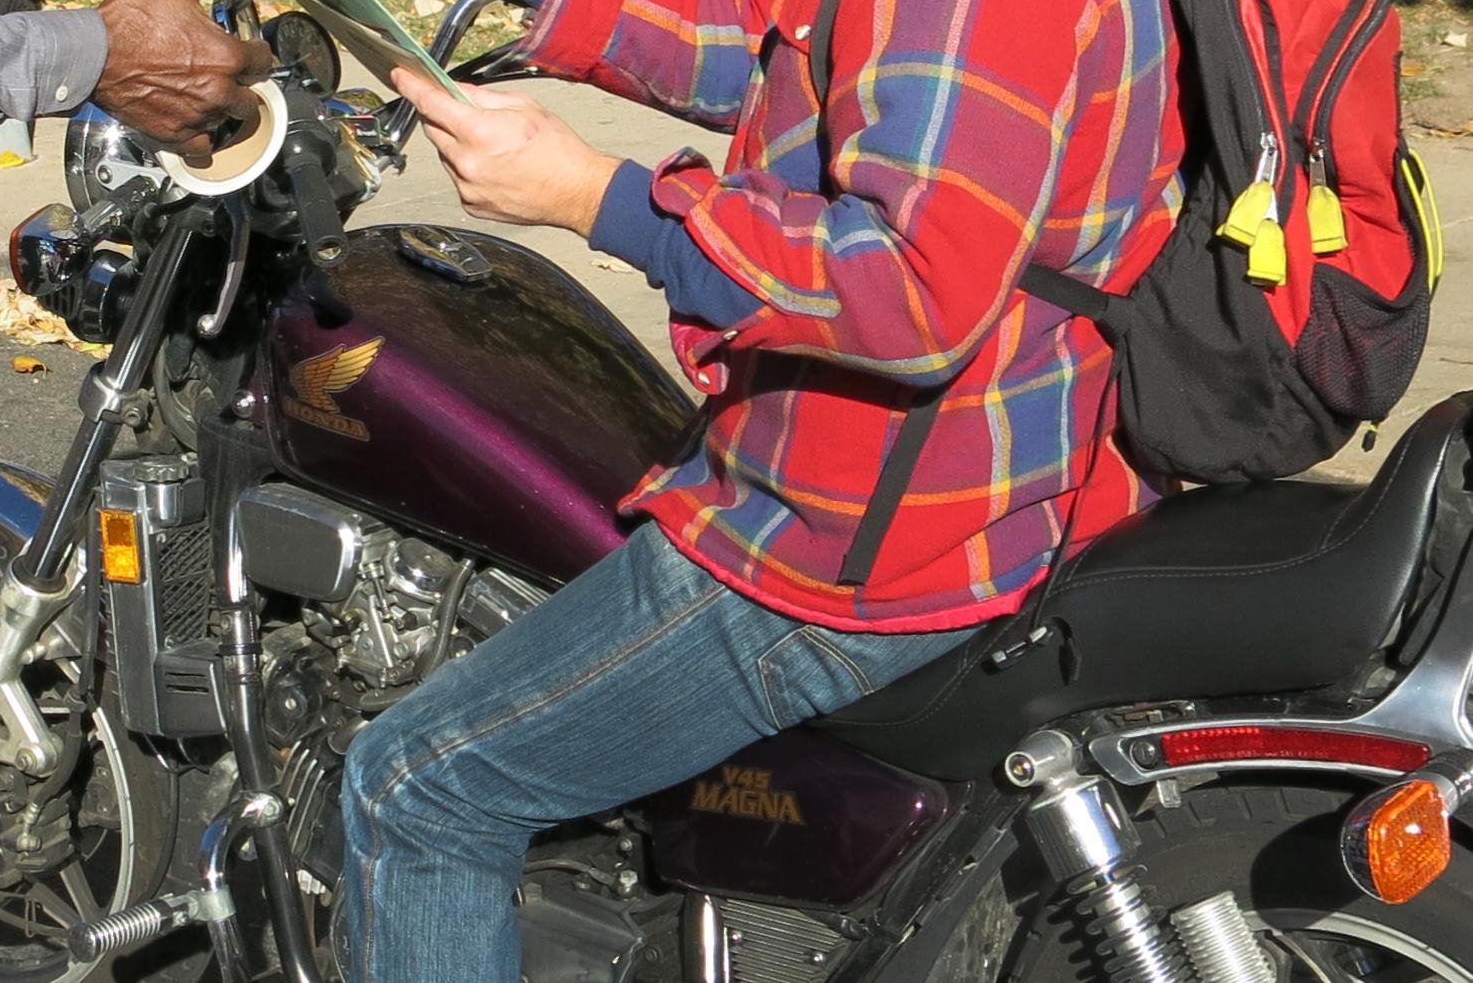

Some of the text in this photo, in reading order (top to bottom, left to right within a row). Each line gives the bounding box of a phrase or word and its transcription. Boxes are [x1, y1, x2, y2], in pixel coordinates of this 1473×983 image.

[283, 398, 368, 439] HONDA
[723, 764, 773, 788] V45
[689, 782, 805, 826] MAGNA
